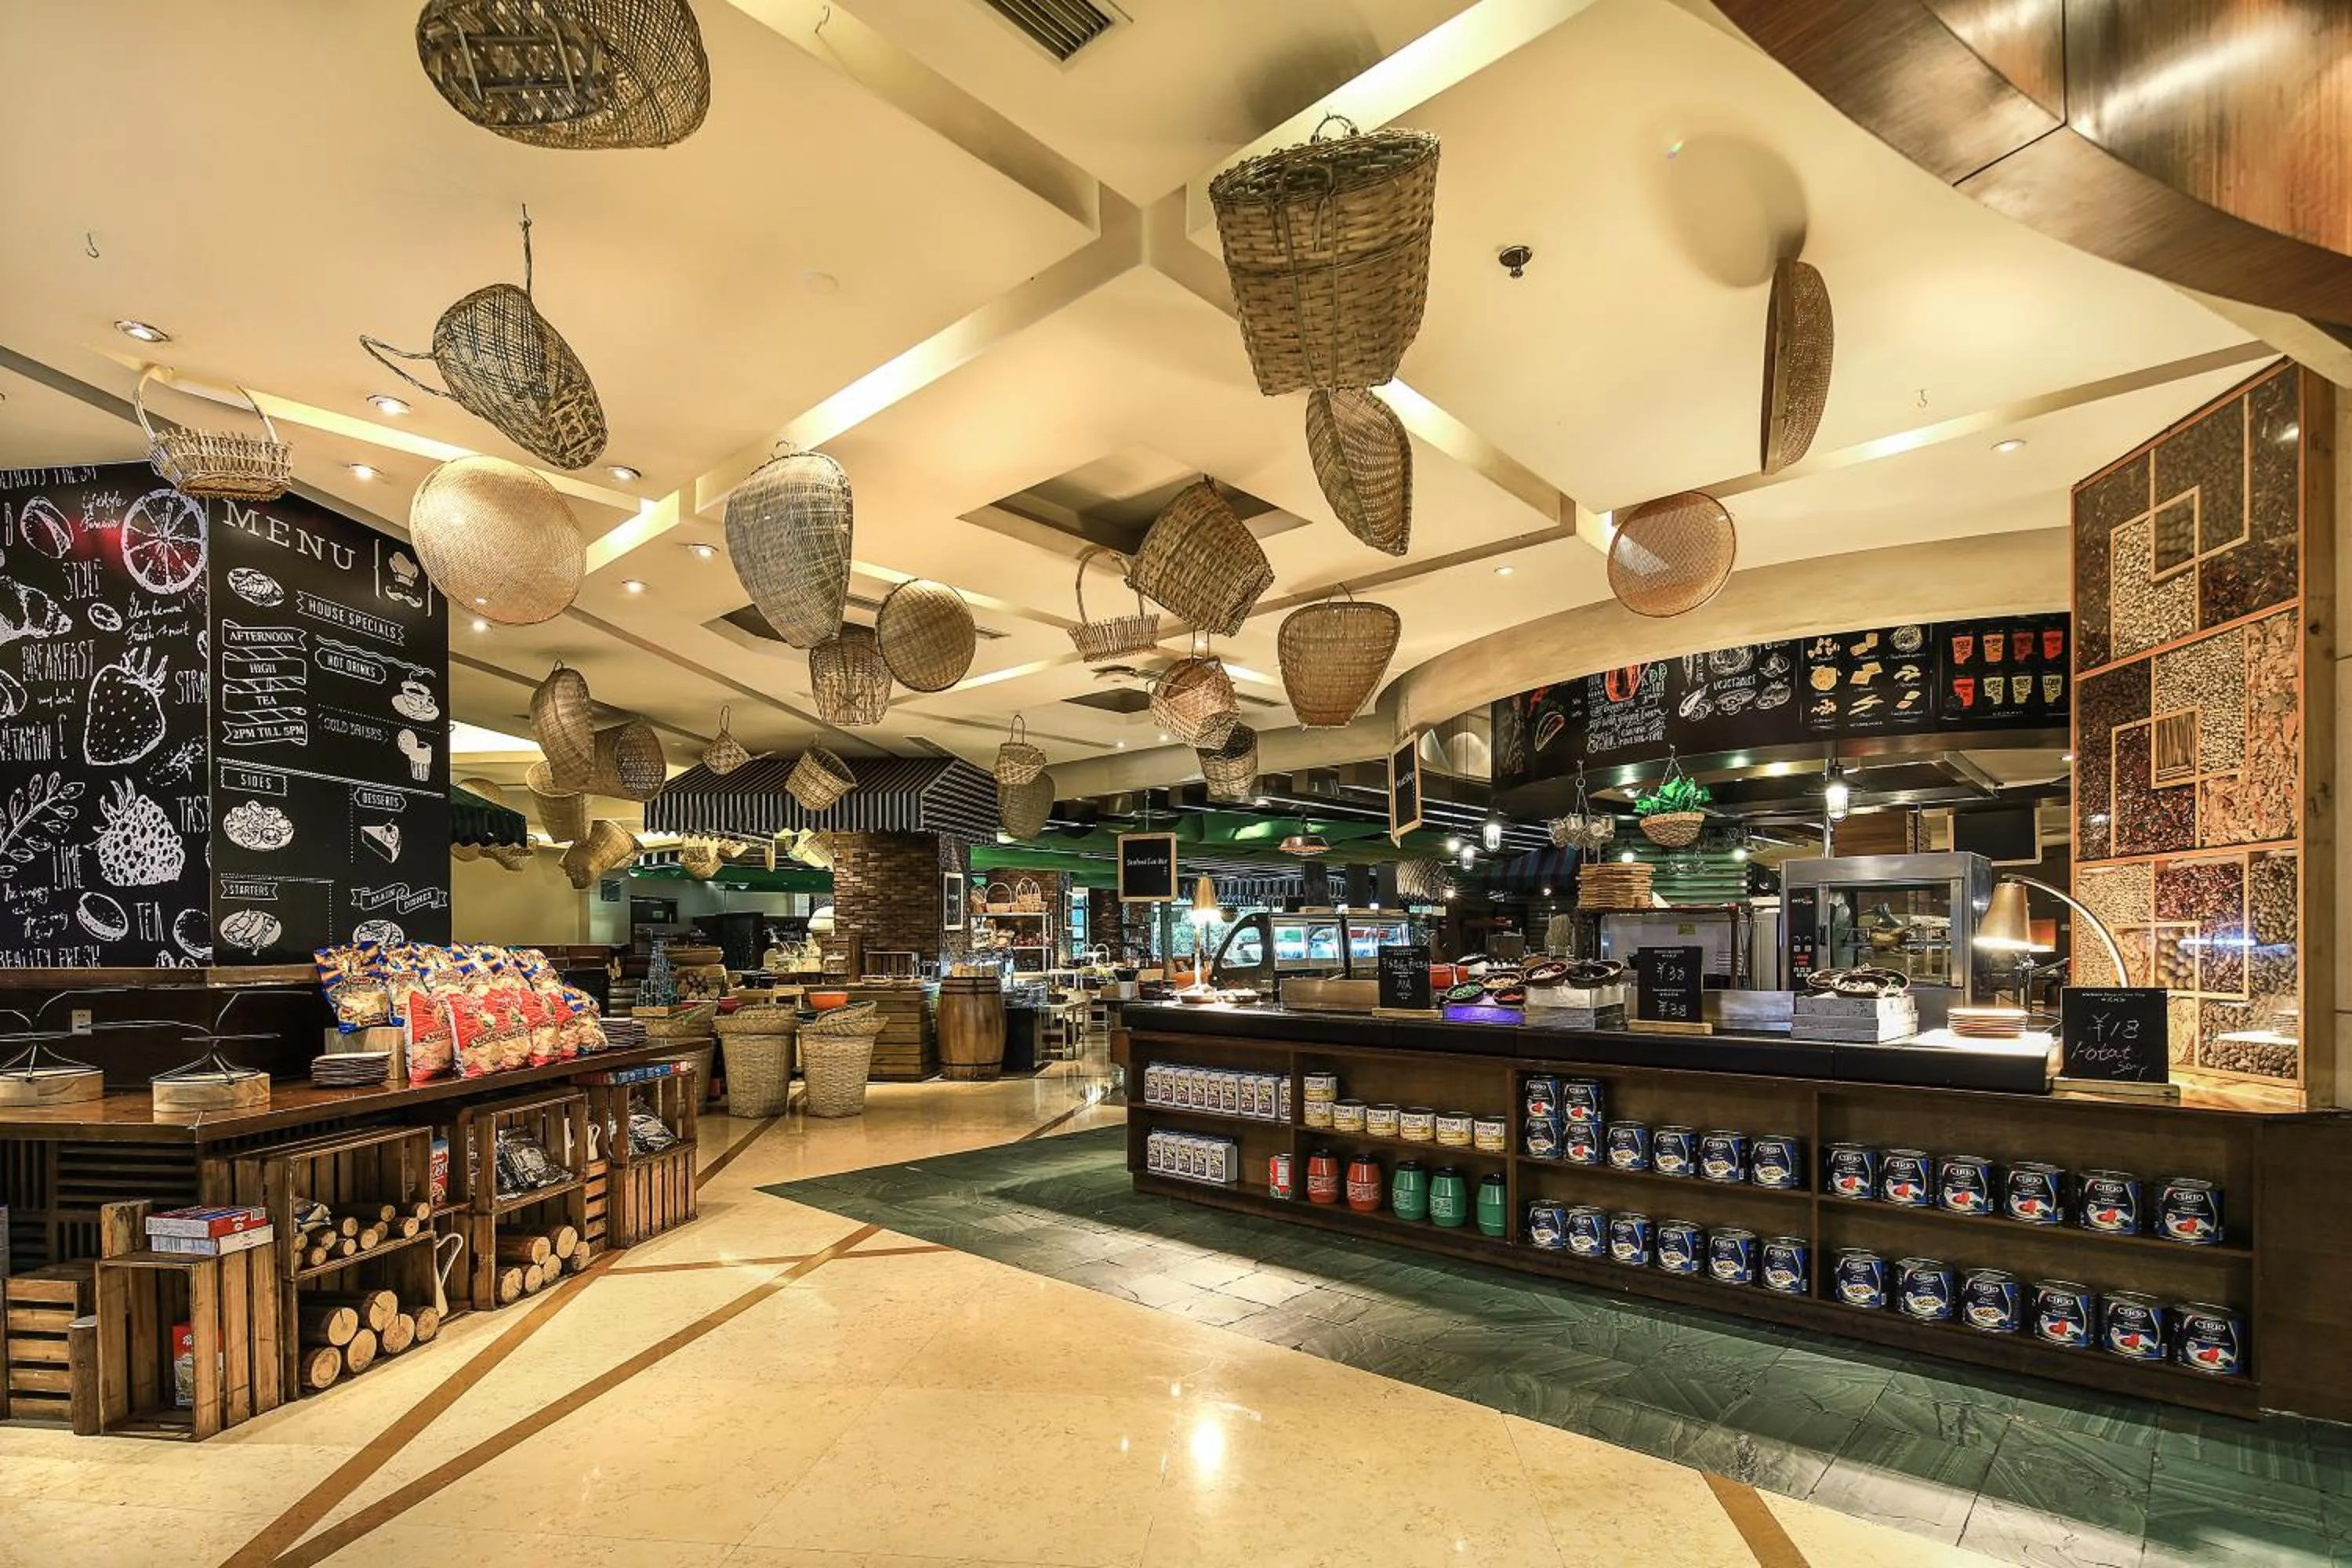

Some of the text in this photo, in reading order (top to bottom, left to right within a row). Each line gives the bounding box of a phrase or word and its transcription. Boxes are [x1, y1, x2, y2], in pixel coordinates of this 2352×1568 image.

[223, 499, 356, 570] MENU
[63, 559, 103, 601] STYLE
[308, 600, 397, 639] HOUSE SPECIALS
[230, 630, 295, 643] AFTERNOON
[22, 640, 95, 682] BREAKFAST
[249, 662, 277, 673] HIGH
[327, 655, 376, 679] HOT DRINKS
[255, 695, 278, 706] TEA
[234, 724, 305, 739] 2PM TILL 5PM
[323, 717, 348, 734] COLD
[241, 773, 272, 789] SIDES
[361, 790, 399, 808] DESSERTS
[230, 884, 270, 896] STARTERS
[370, 888, 432, 910] MAIN DISHES
